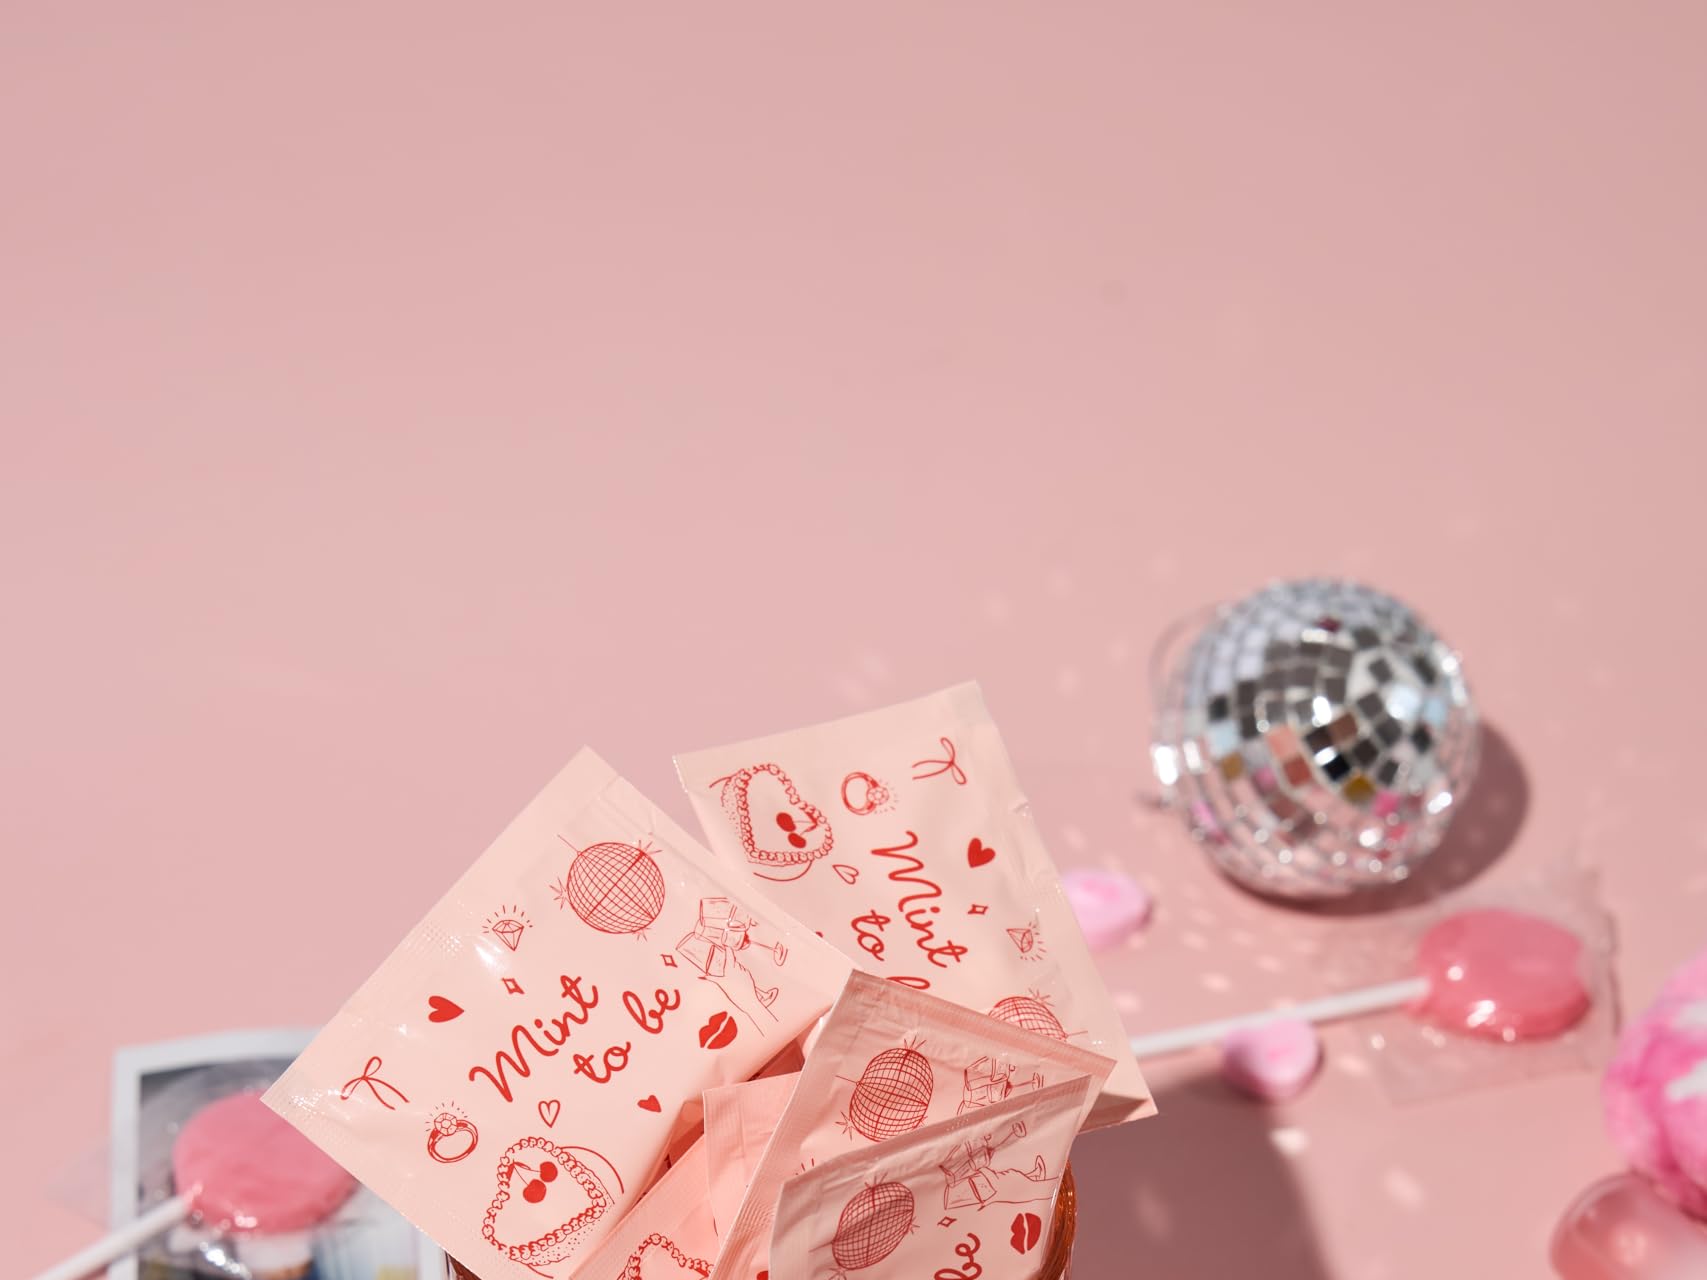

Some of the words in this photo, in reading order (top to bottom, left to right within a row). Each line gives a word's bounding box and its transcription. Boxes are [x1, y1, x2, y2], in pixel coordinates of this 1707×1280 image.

[851, 910, 891, 961] to
[871, 831, 968, 967] Mint
[469, 975, 598, 1102] Mint
[573, 1041, 631, 1083] to
[622, 989, 680, 1034] be
